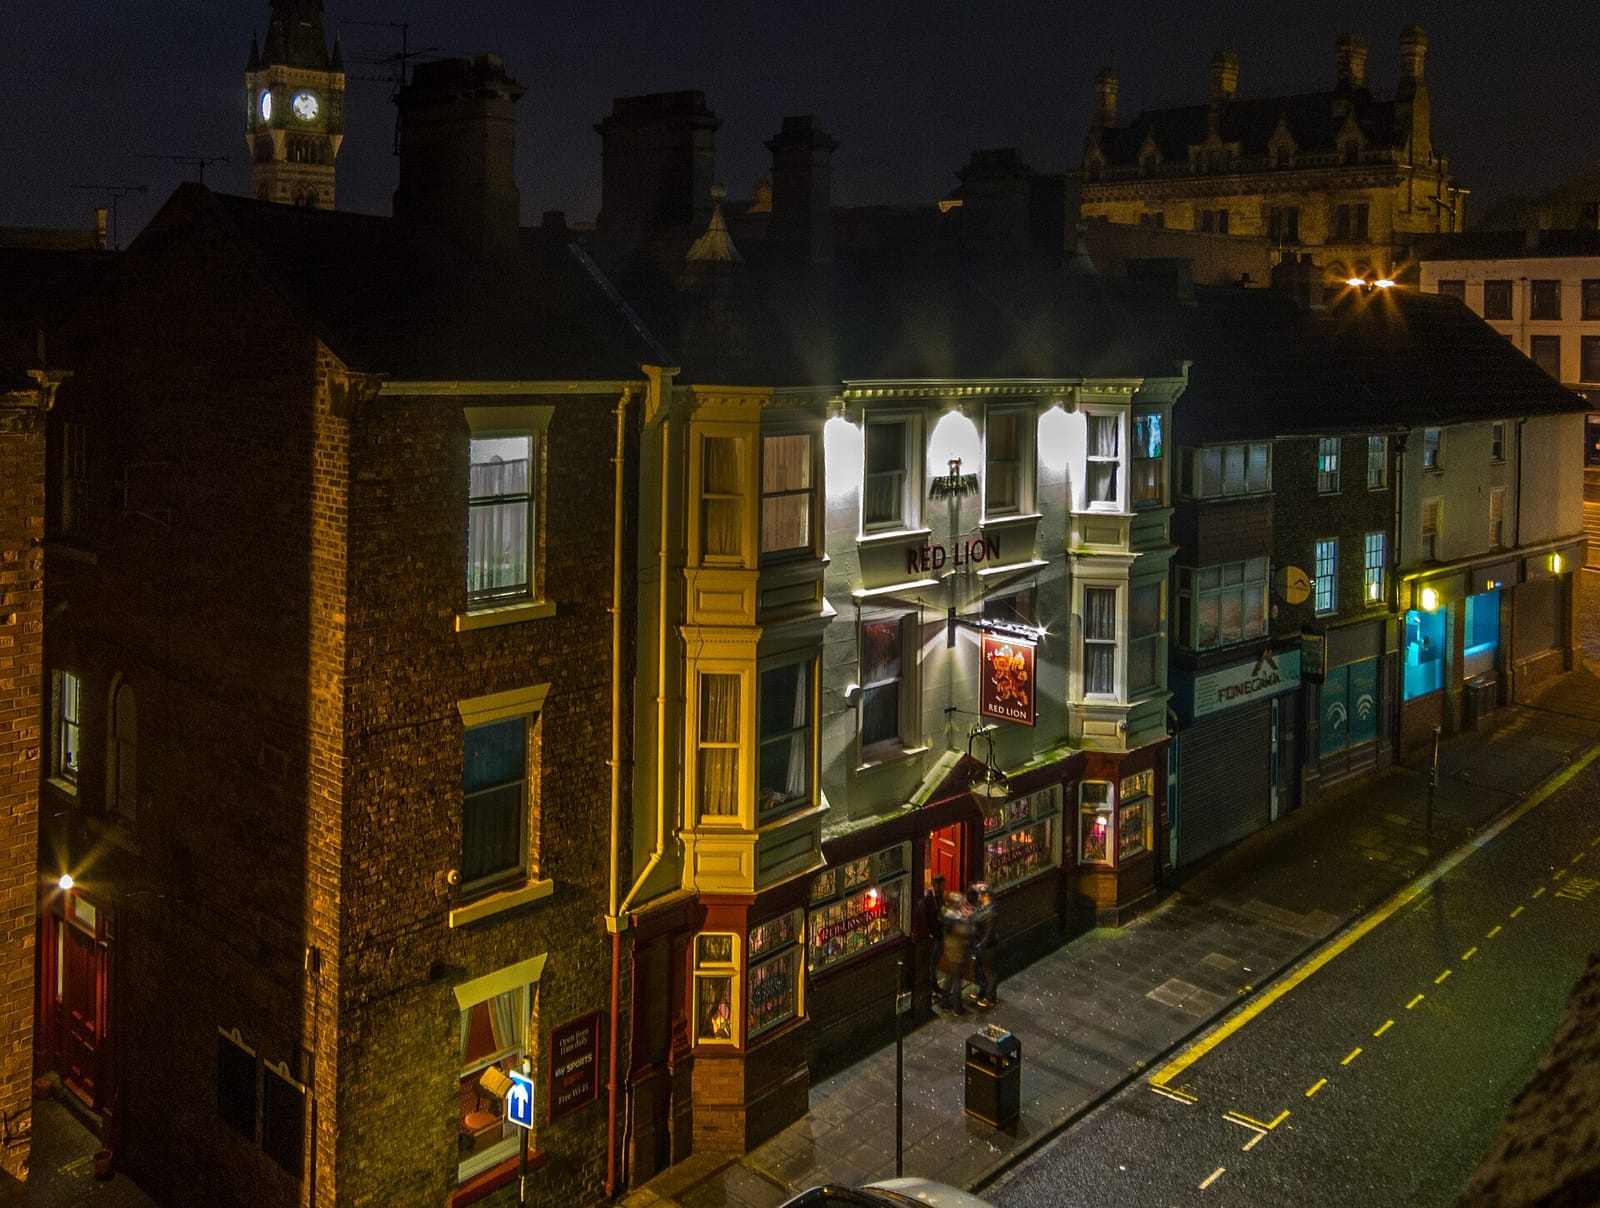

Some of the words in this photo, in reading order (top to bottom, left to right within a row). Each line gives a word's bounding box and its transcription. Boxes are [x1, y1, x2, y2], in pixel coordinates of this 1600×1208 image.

[907, 544, 946, 575] RED
[953, 536, 1001, 566] LION
[988, 702, 1005, 715] RED
[1005, 706, 1027, 720] LION
[567, 1052, 593, 1072] SPORTS
